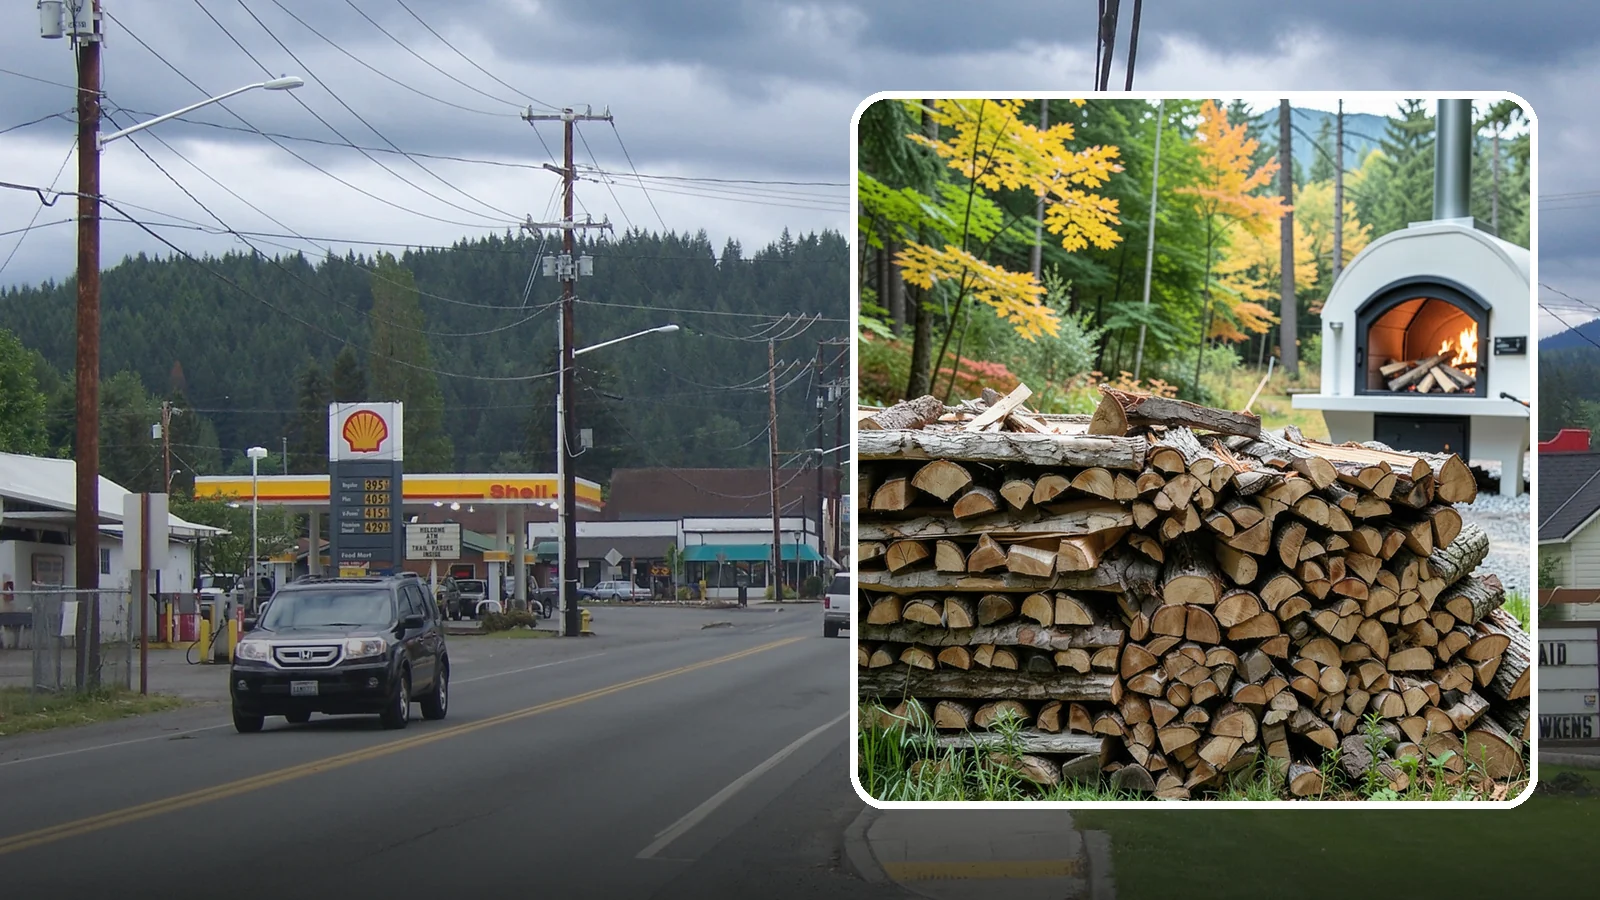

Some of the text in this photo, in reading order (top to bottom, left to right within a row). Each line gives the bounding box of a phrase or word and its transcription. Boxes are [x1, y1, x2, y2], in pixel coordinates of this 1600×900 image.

[365, 480, 384, 490] 395
[490, 484, 547, 499] Shell
[365, 494, 384, 504] 405
[365, 508, 384, 518] 415
[365, 522, 384, 532] 429
[1539, 642, 1567, 666] AID
